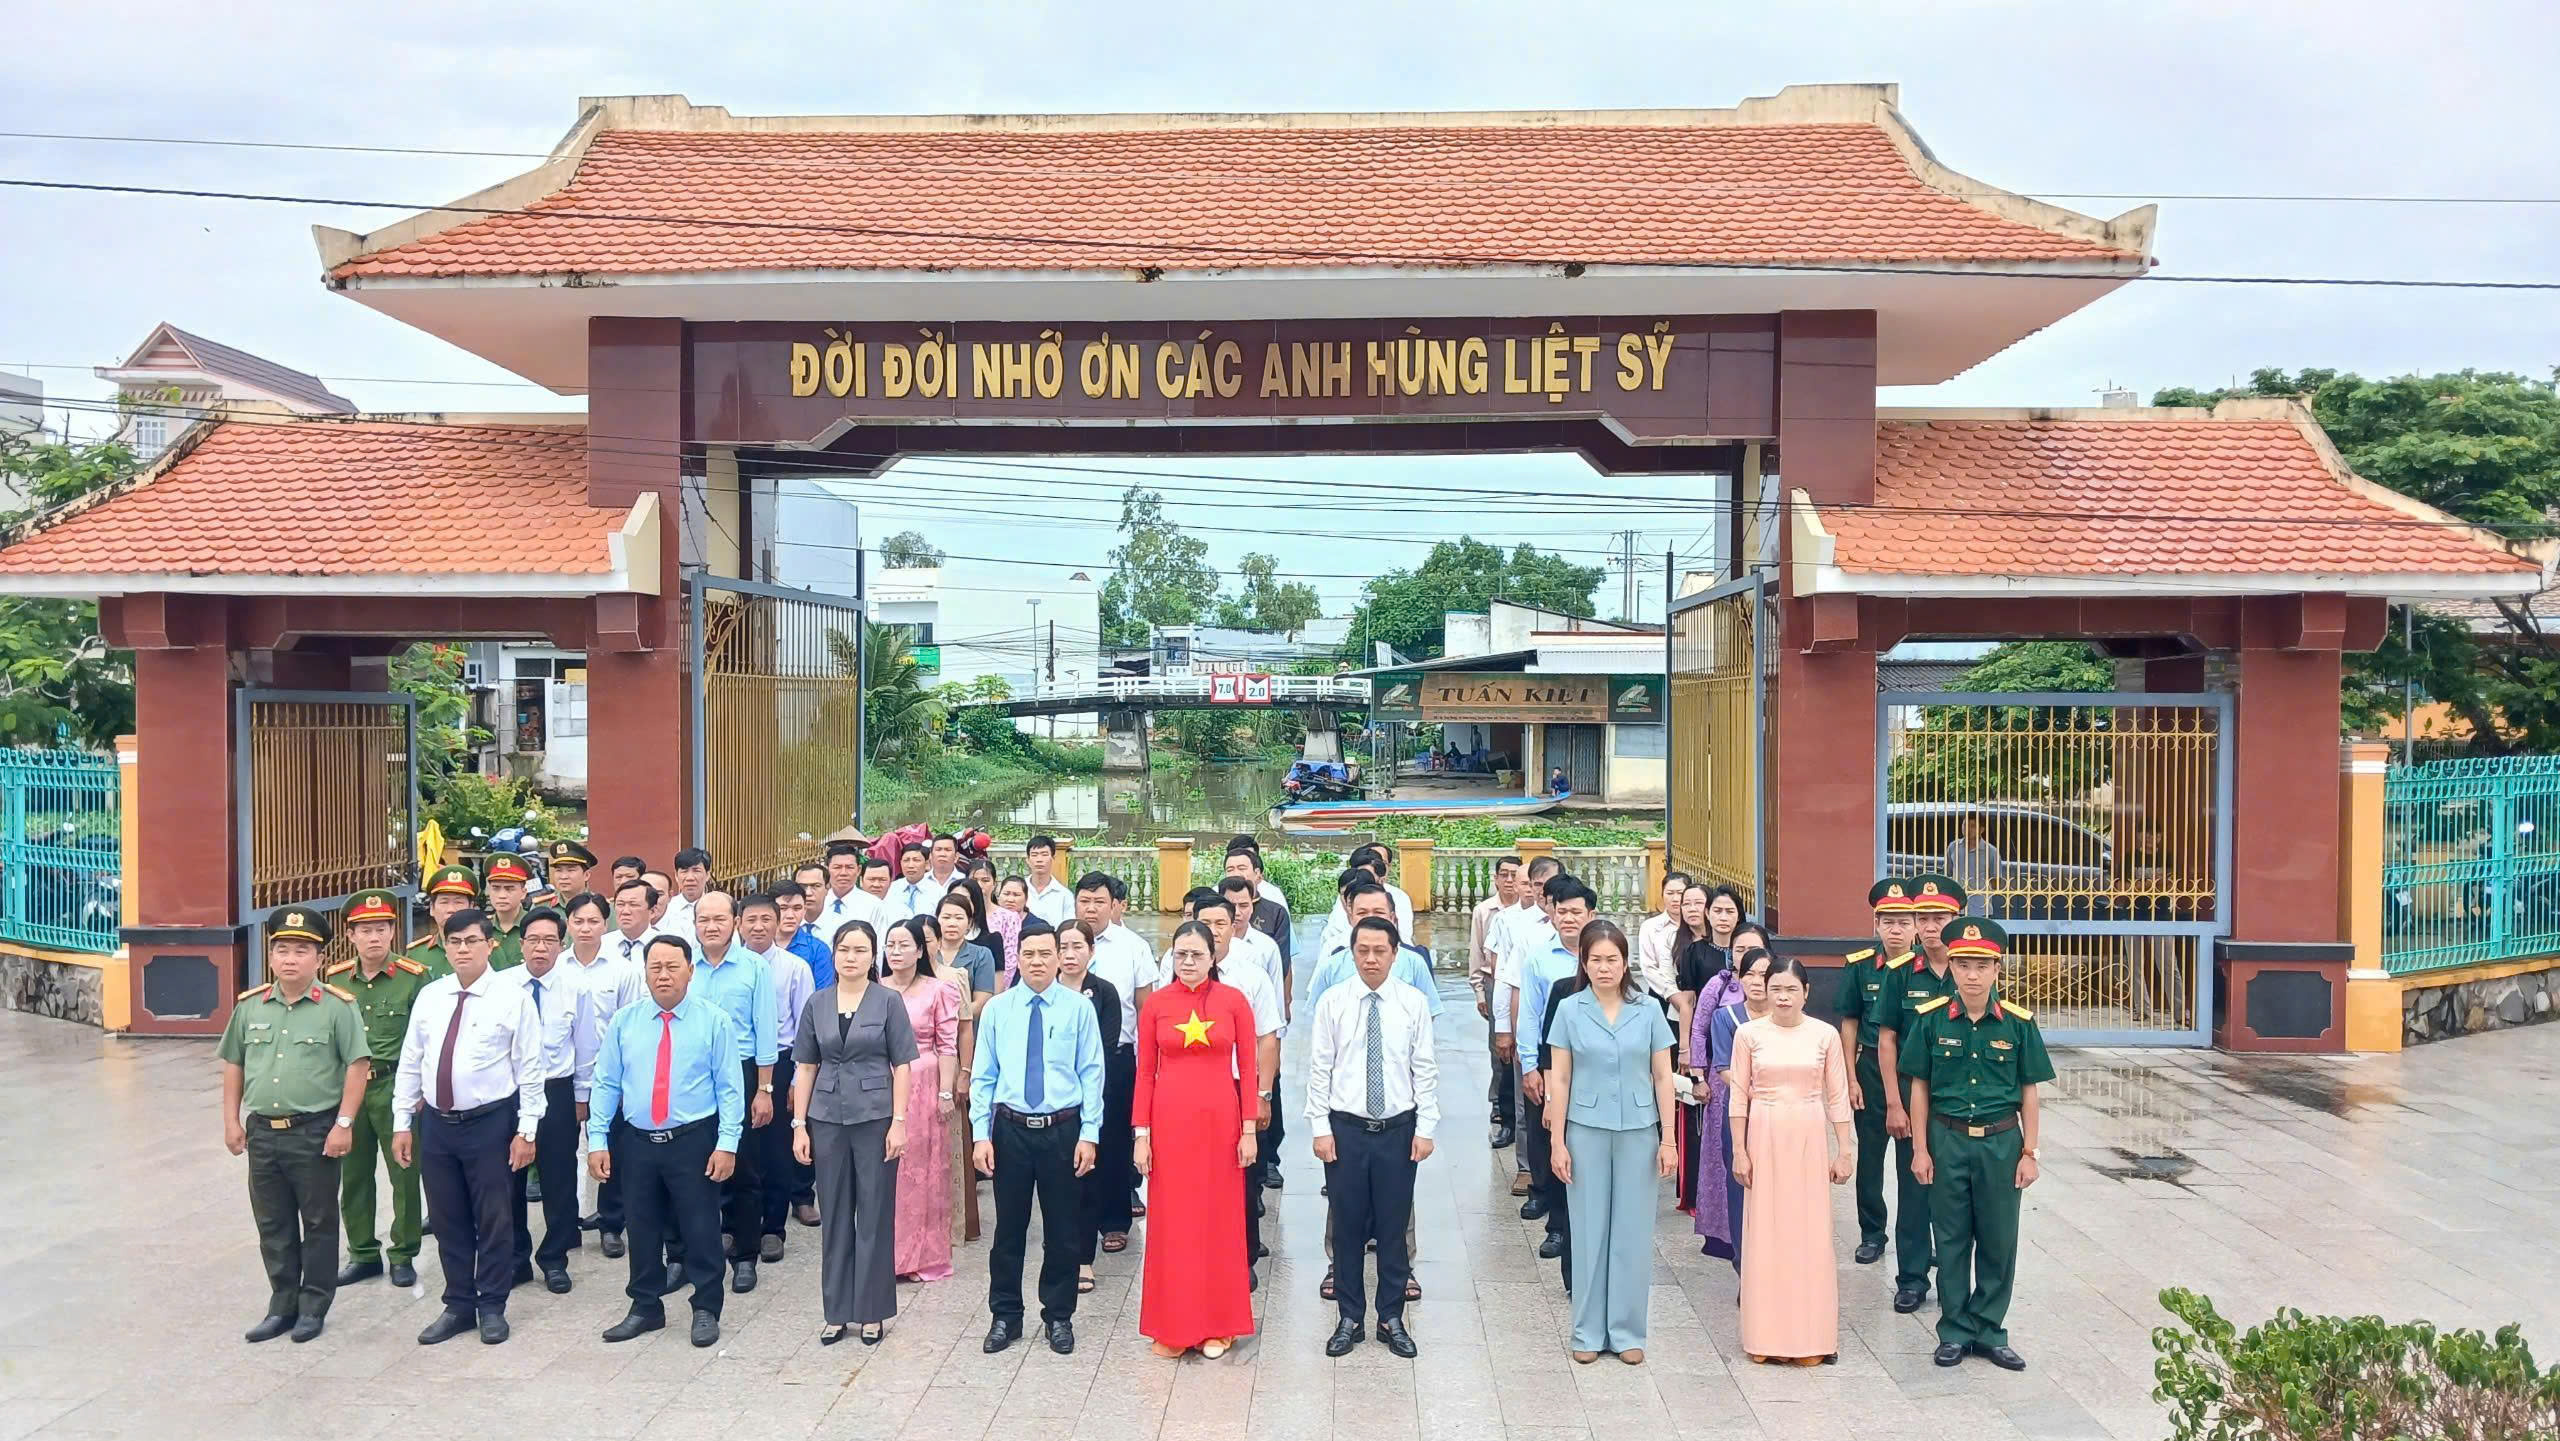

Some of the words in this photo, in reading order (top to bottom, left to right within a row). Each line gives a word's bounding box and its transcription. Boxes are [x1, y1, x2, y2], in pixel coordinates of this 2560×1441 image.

[790, 328, 867, 398] ĐỜI
[882, 328, 958, 398] ĐỜI
[972, 328, 1064, 399] NHỚ
[1080, 331, 1140, 399] ƠN
[1156, 329, 1244, 399] CÁC
[1260, 342, 1351, 398] ANH
[1367, 325, 1489, 398] HÙNG
[1505, 321, 1601, 403] LIỆT
[1616, 320, 1676, 392] SỸ
[1437, 681, 1512, 702] TUẤN
